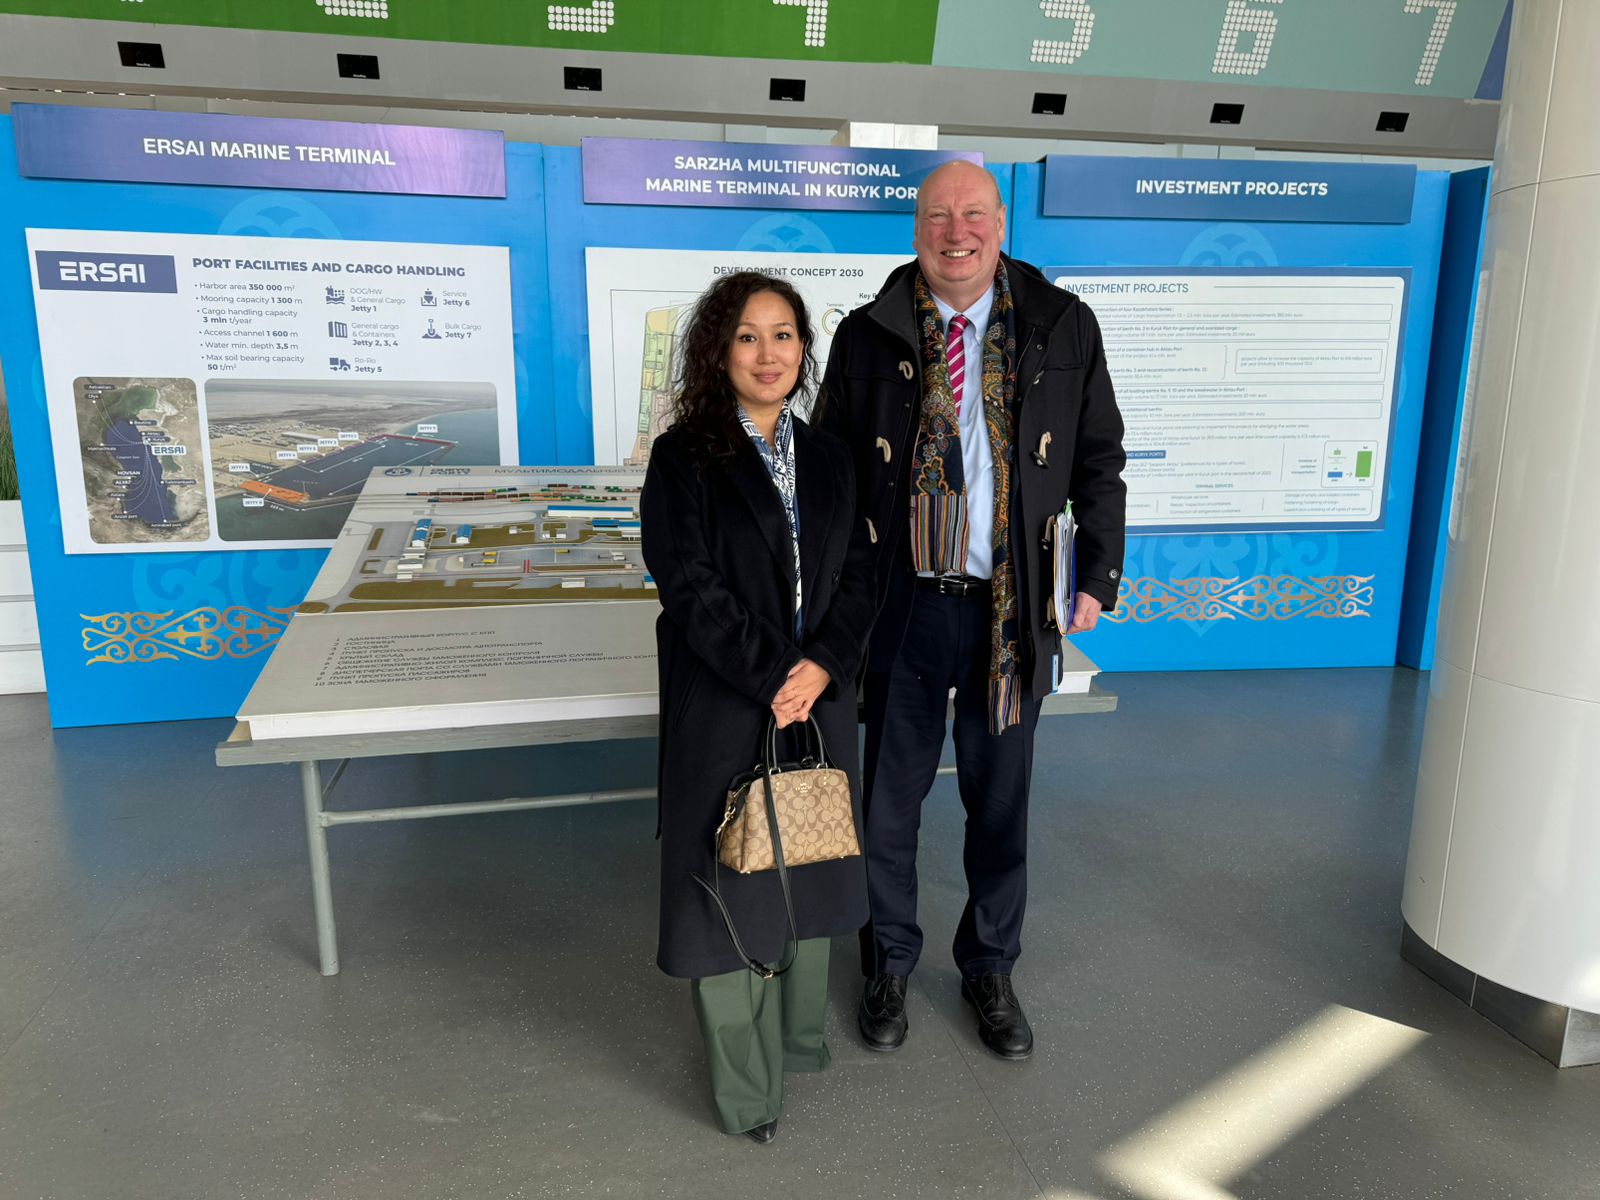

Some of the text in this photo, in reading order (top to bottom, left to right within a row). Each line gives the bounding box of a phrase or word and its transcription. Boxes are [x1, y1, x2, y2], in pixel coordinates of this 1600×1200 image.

[143, 137, 396, 167] ERSAI MARINE TERMINAL
[674, 155, 901, 178] SARZHA MULTIFUNCTIONAL
[645, 177, 920, 200] MARINE TERMINAL IN KURYK POR
[1135, 179, 1329, 197] INVESTMENT PROJECTS
[58, 261, 146, 283] ERSAI
[192, 258, 466, 277] PORT FACILITIES AND CARGO HANDLING
[790, 267, 836, 278] CONCEPT
[839, 268, 865, 278] 2030
[199, 282, 227, 290] Harbor
[1064, 283, 1189, 294] INVESTMENT PROJECTS
[200, 295, 234, 304] Mooring
[236, 296, 270, 305] capacity
[357, 296, 384, 304] General
[385, 297, 406, 306] Cargo
[442, 299, 464, 307] Jetty
[201, 308, 298, 318] Cargo handling capacity
[350, 305, 372, 313] Jetty
[229, 318, 252, 326] t/year
[351, 322, 378, 330] General
[204, 329, 232, 337] Access
[461, 324, 482, 332] Cargo
[444, 331, 466, 340] Jetty
[250, 342, 274, 350] depth
[352, 339, 373, 348] Jetty
[374, 340, 383, 348] 2,
[240, 354, 270, 363] bearing
[272, 355, 304, 364] capacity
[354, 366, 376, 374] Jetty
